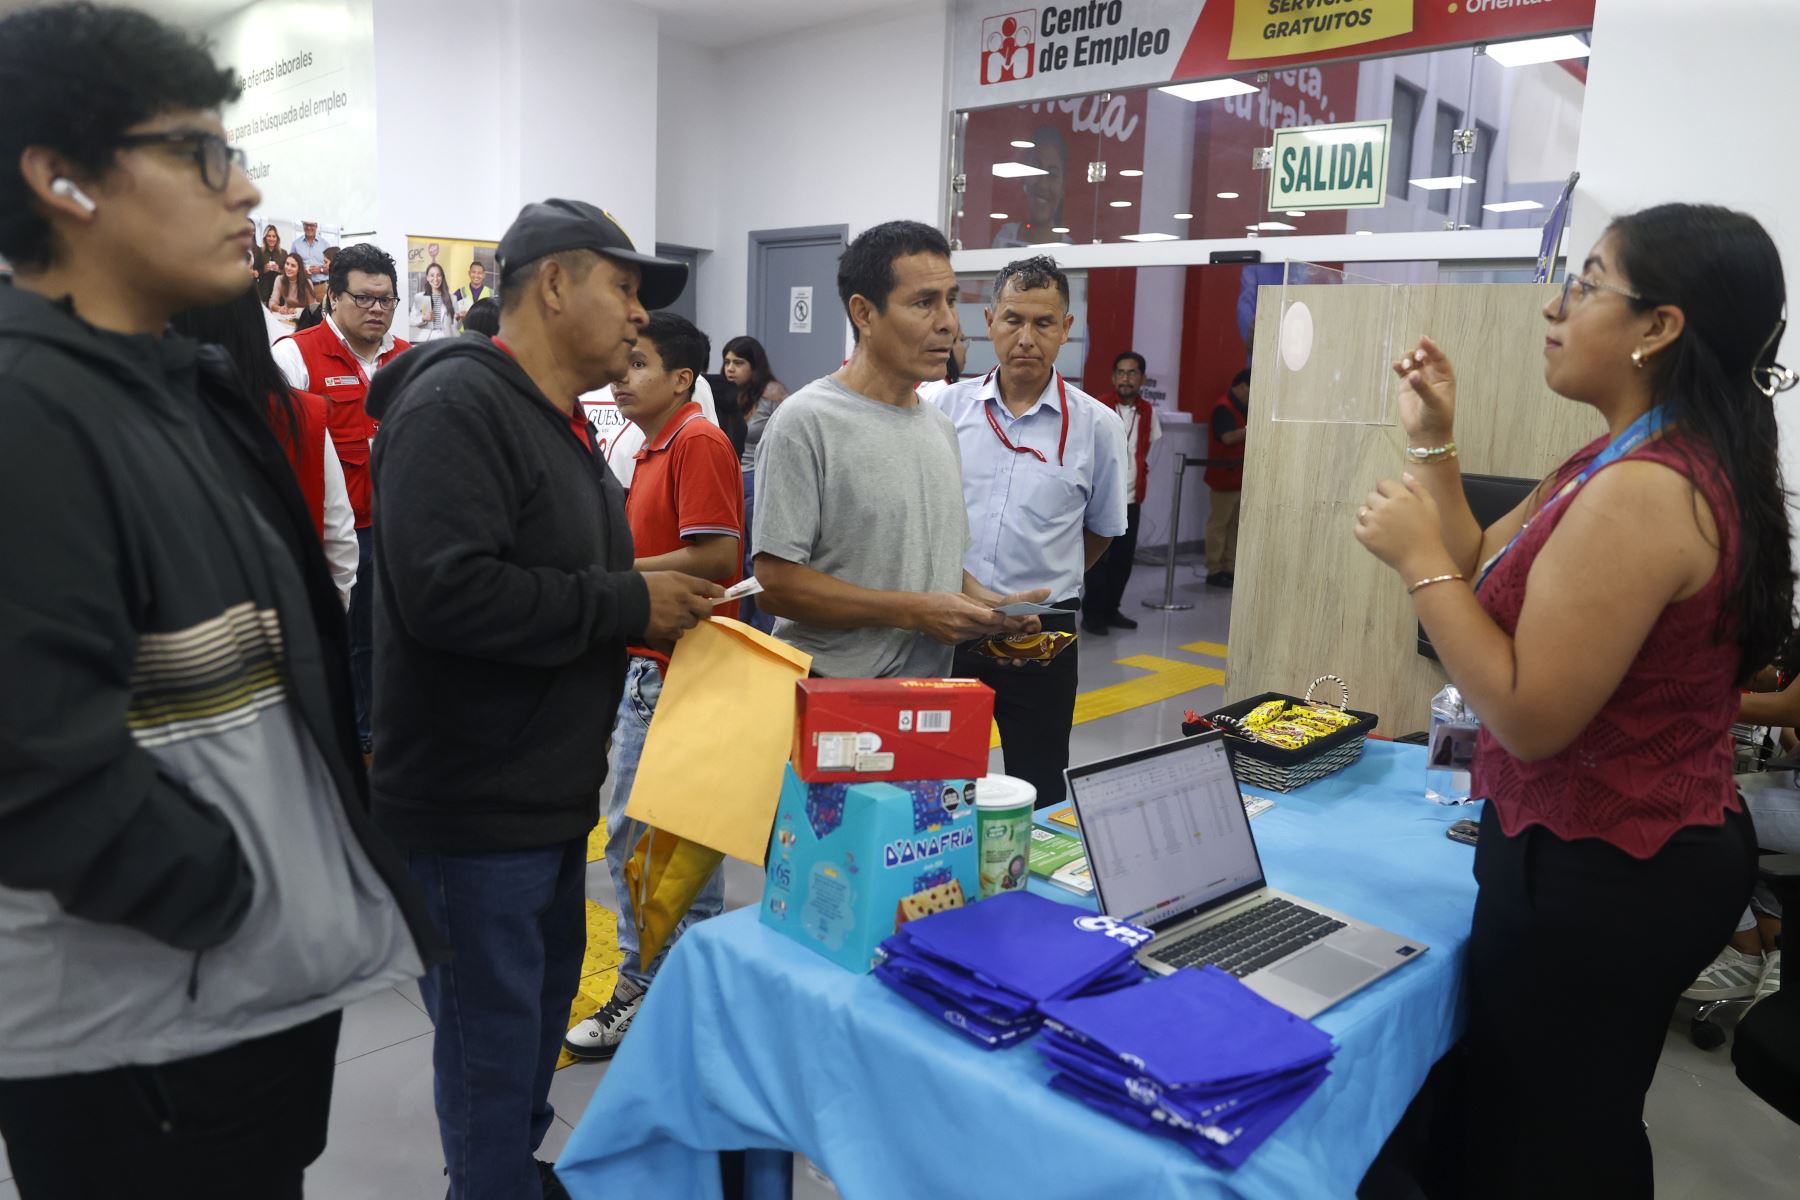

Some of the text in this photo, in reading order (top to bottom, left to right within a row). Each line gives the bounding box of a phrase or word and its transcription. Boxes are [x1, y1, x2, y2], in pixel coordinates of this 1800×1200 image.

[1041, 0, 1122, 37] Centro
[1263, 8, 1373, 40] GRATUITOS
[1268, 0, 1353, 15] SERVI
[1465, 0, 1553, 13] Orien
[1039, 27, 1170, 73] de Empleo
[248, 67, 275, 89] ofertas
[275, 50, 313, 78] laborales
[235, 122, 252, 143] para
[252, 118, 259, 136] la
[260, 105, 298, 132] búsqueda
[299, 97, 312, 119] del
[313, 90, 347, 116] empleo
[245, 162, 270, 181] ostular
[1280, 142, 1373, 194] SALIDA
